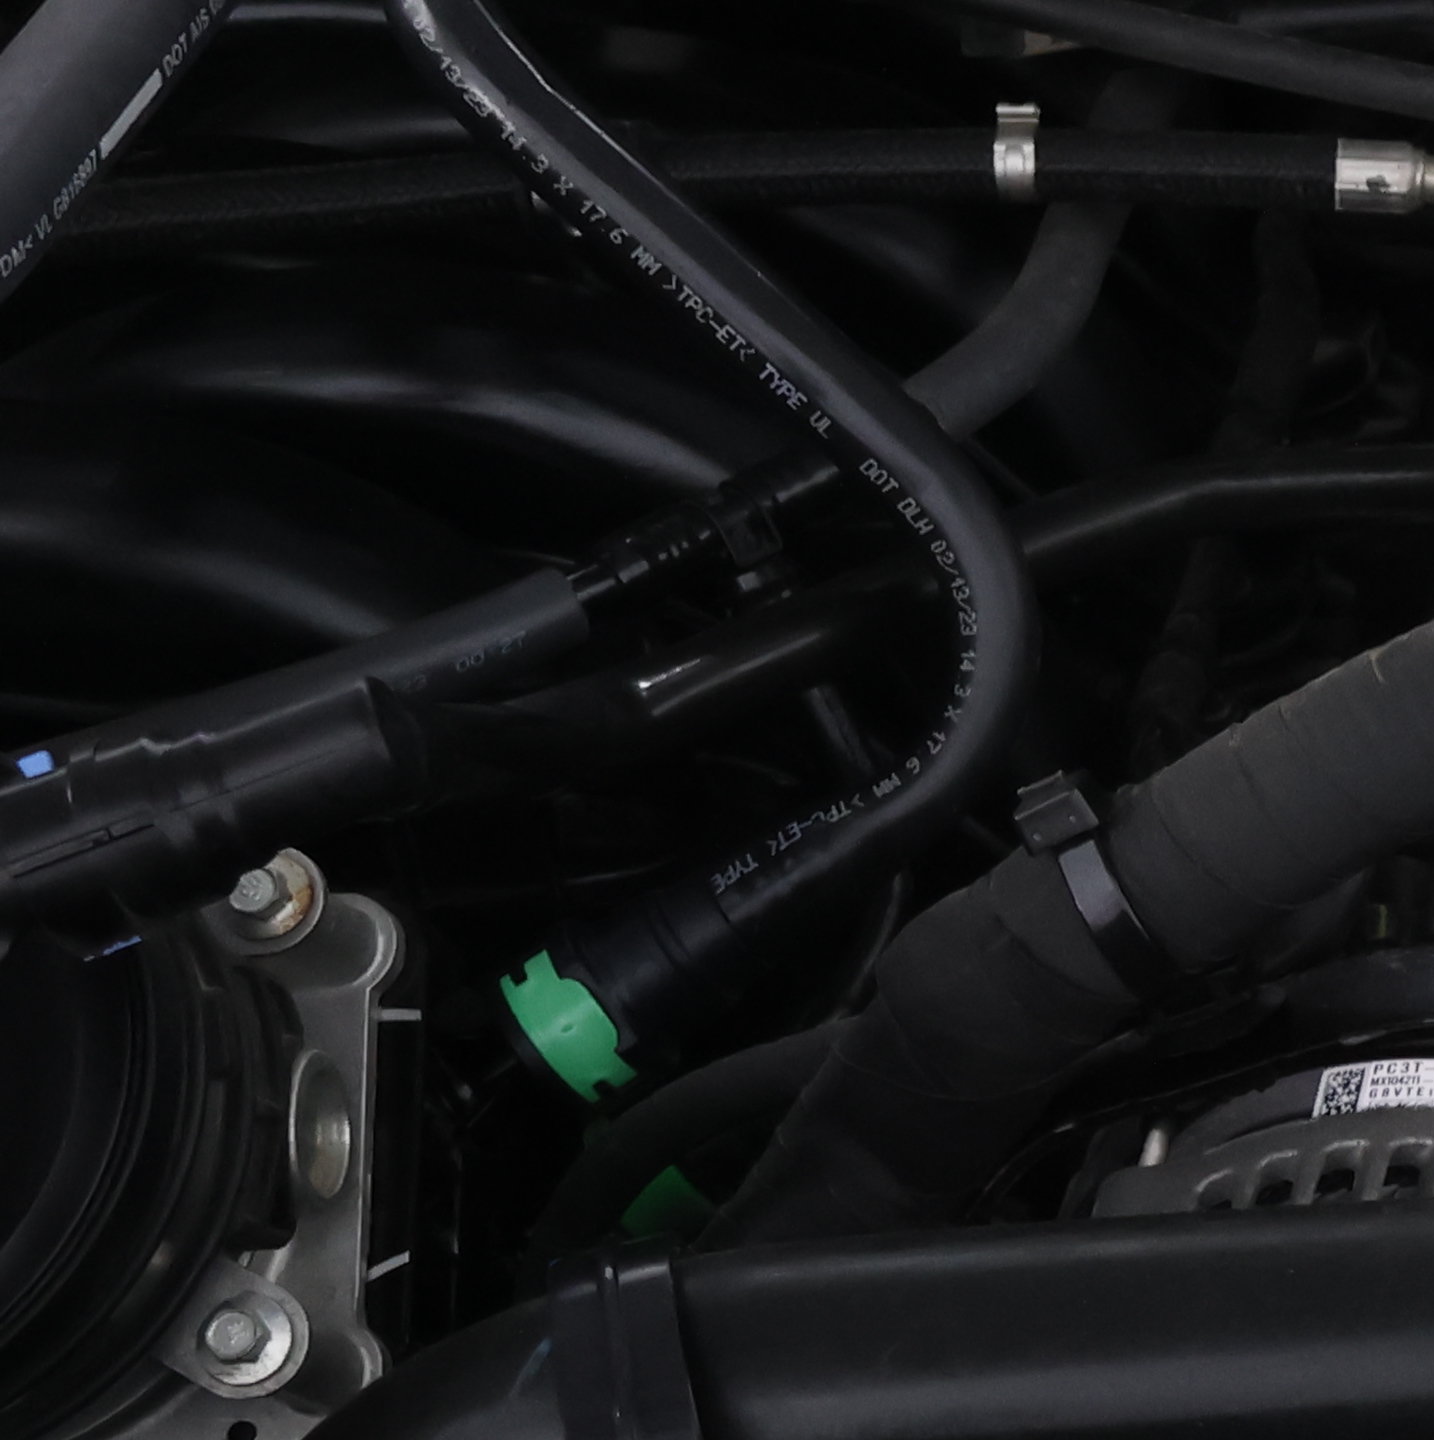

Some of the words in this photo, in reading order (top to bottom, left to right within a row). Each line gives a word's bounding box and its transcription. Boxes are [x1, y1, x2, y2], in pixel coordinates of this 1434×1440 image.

[161, 31, 191, 79] DOT
[34, 210, 55, 242] VL
[630, 244, 664, 277] MM
[757, 360, 809, 413] TYPE
[807, 409, 837, 441] UL
[857, 455, 901, 495] DOT
[895, 494, 938, 538] DLH
[708, 849, 761, 897] TYPE
